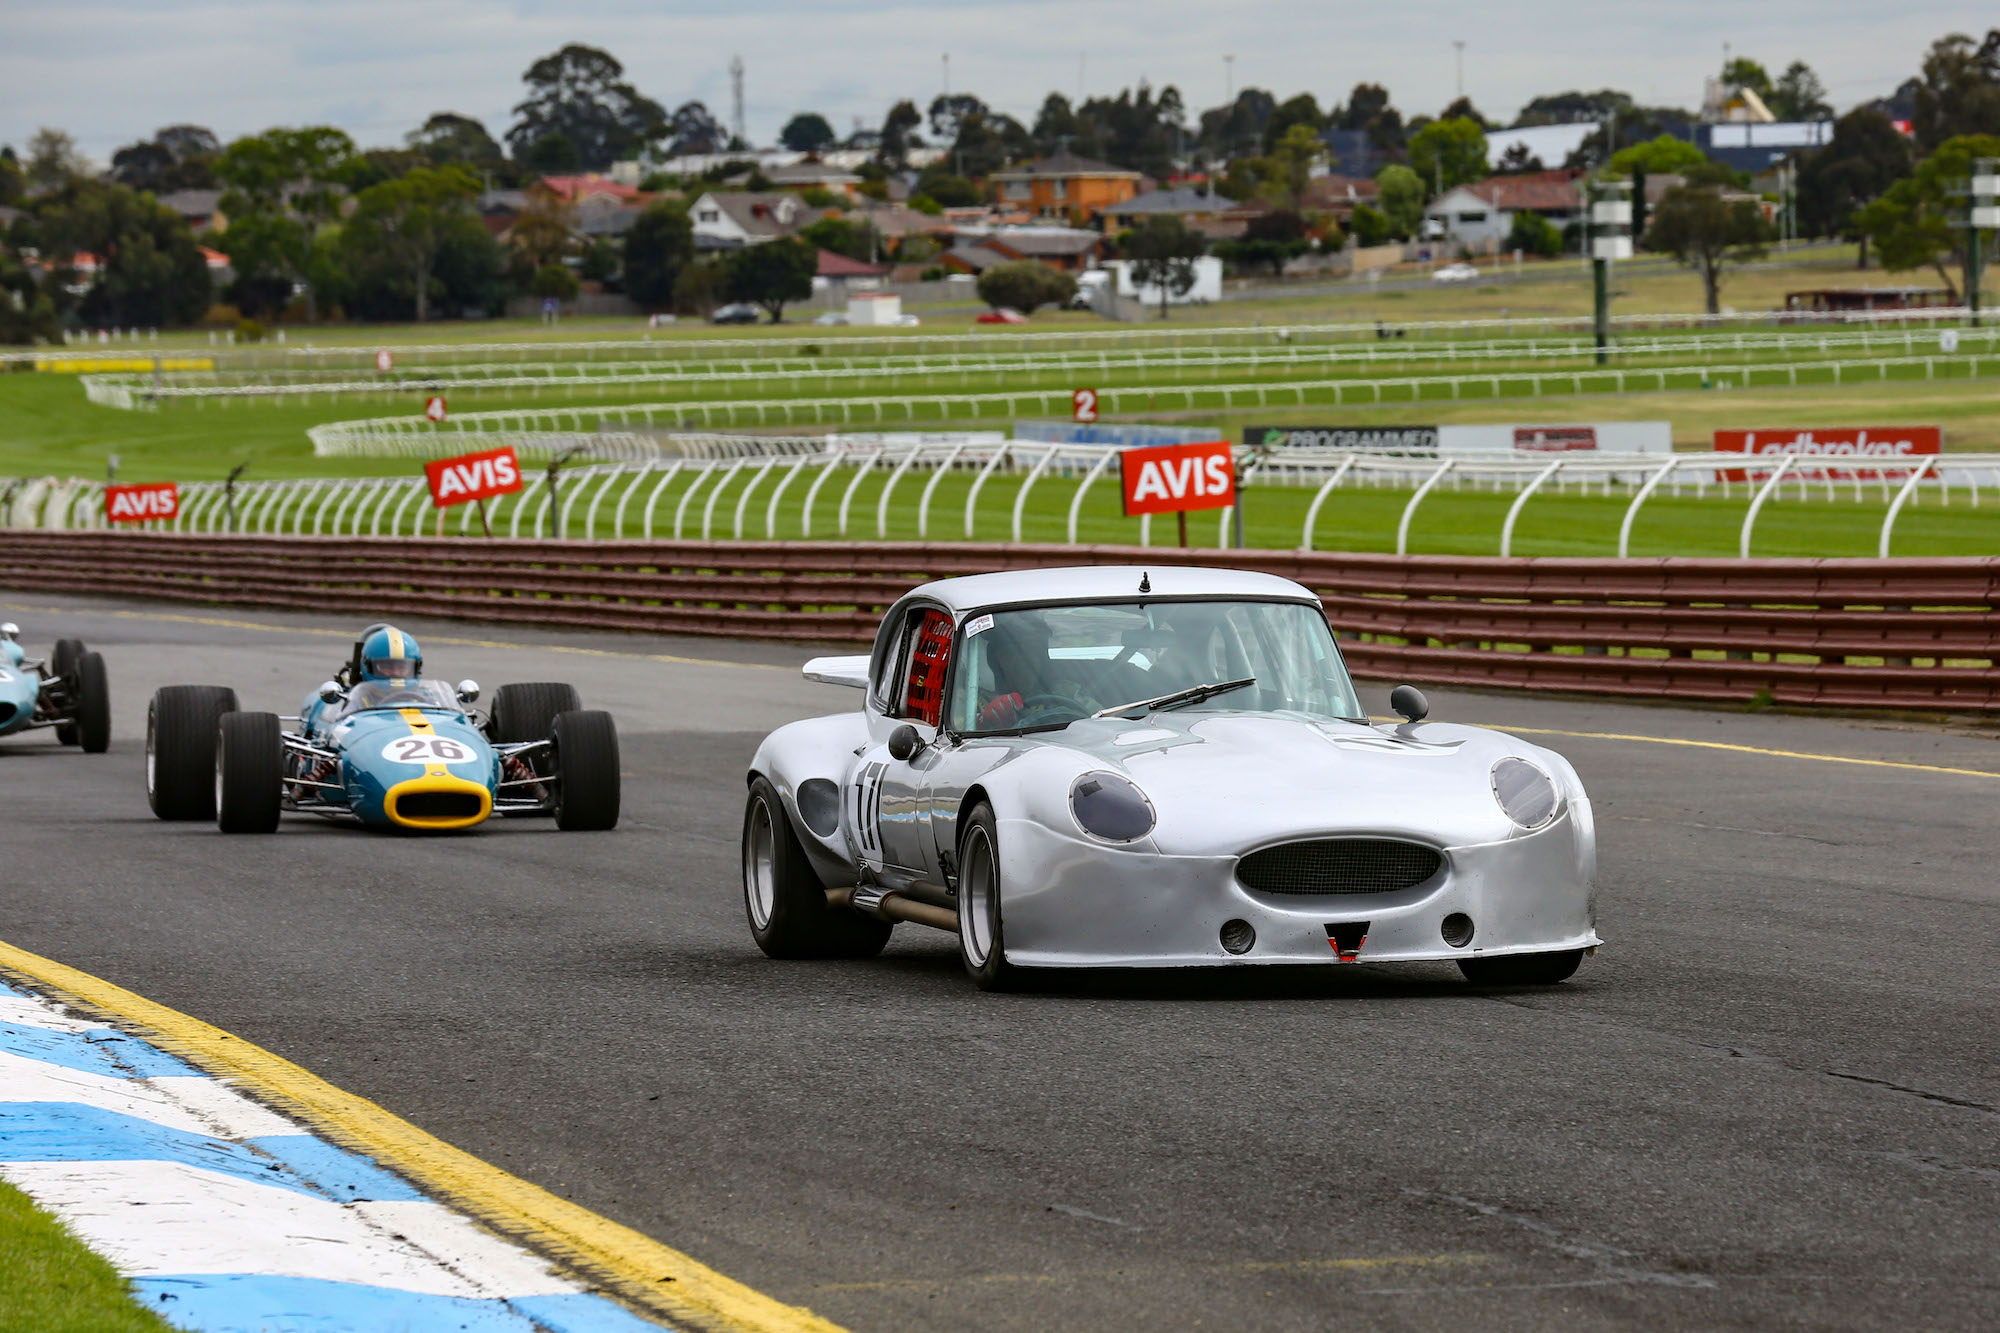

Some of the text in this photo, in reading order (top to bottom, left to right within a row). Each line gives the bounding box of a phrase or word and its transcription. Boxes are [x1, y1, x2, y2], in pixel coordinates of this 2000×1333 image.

[427, 397, 443, 420] 4
[1074, 390, 1096, 420] 2
[439, 455, 516, 498] AVIS
[1133, 454, 1230, 501] AVIS
[111, 490, 176, 516] AVIS
[396, 740, 464, 760] 26
